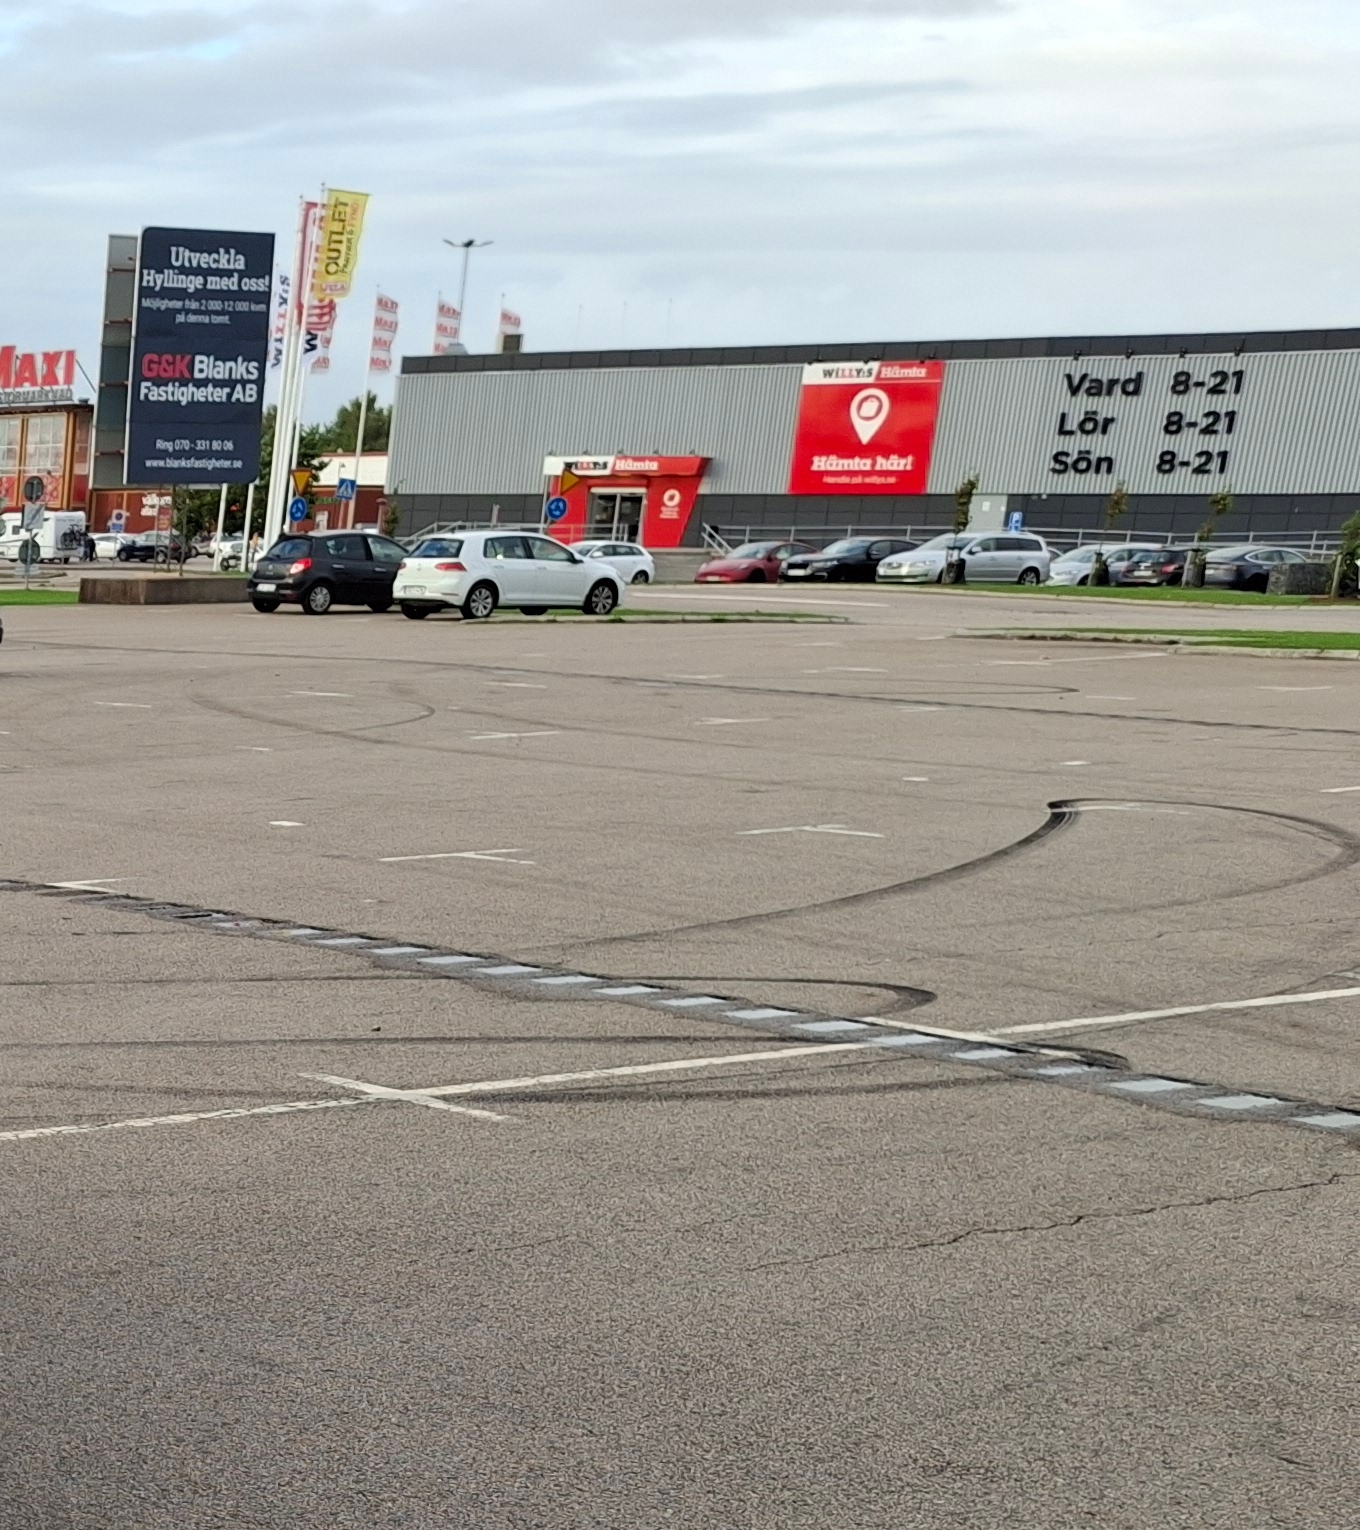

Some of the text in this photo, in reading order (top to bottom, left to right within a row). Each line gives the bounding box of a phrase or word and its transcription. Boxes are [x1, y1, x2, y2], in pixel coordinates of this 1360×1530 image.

[325, 197, 348, 275] OUTLET
[170, 247, 245, 270] Utveckla
[142, 269, 269, 293] Hyllinge med oss!
[141, 297, 183, 311] Möjligheter
[175, 311, 185, 324] på
[186, 312, 209, 323] denna
[142, 353, 259, 380] G&K Blanks
[880, 365, 927, 378] Hämta
[140, 382, 257, 406] Fastigheter AB
[1065, 370, 1244, 397] Vard 8-21
[1058, 410, 1237, 435] Lör 8-21
[156, 439, 173, 453] Ring
[174, 439, 190, 450] 070
[195, 440, 210, 451] 331
[145, 457, 242, 470] www.blanksfastigheter.se
[615, 459, 659, 471] Hämta
[810, 454, 913, 471] Hämta här!
[1050, 450, 1229, 475] Sön 8-21
